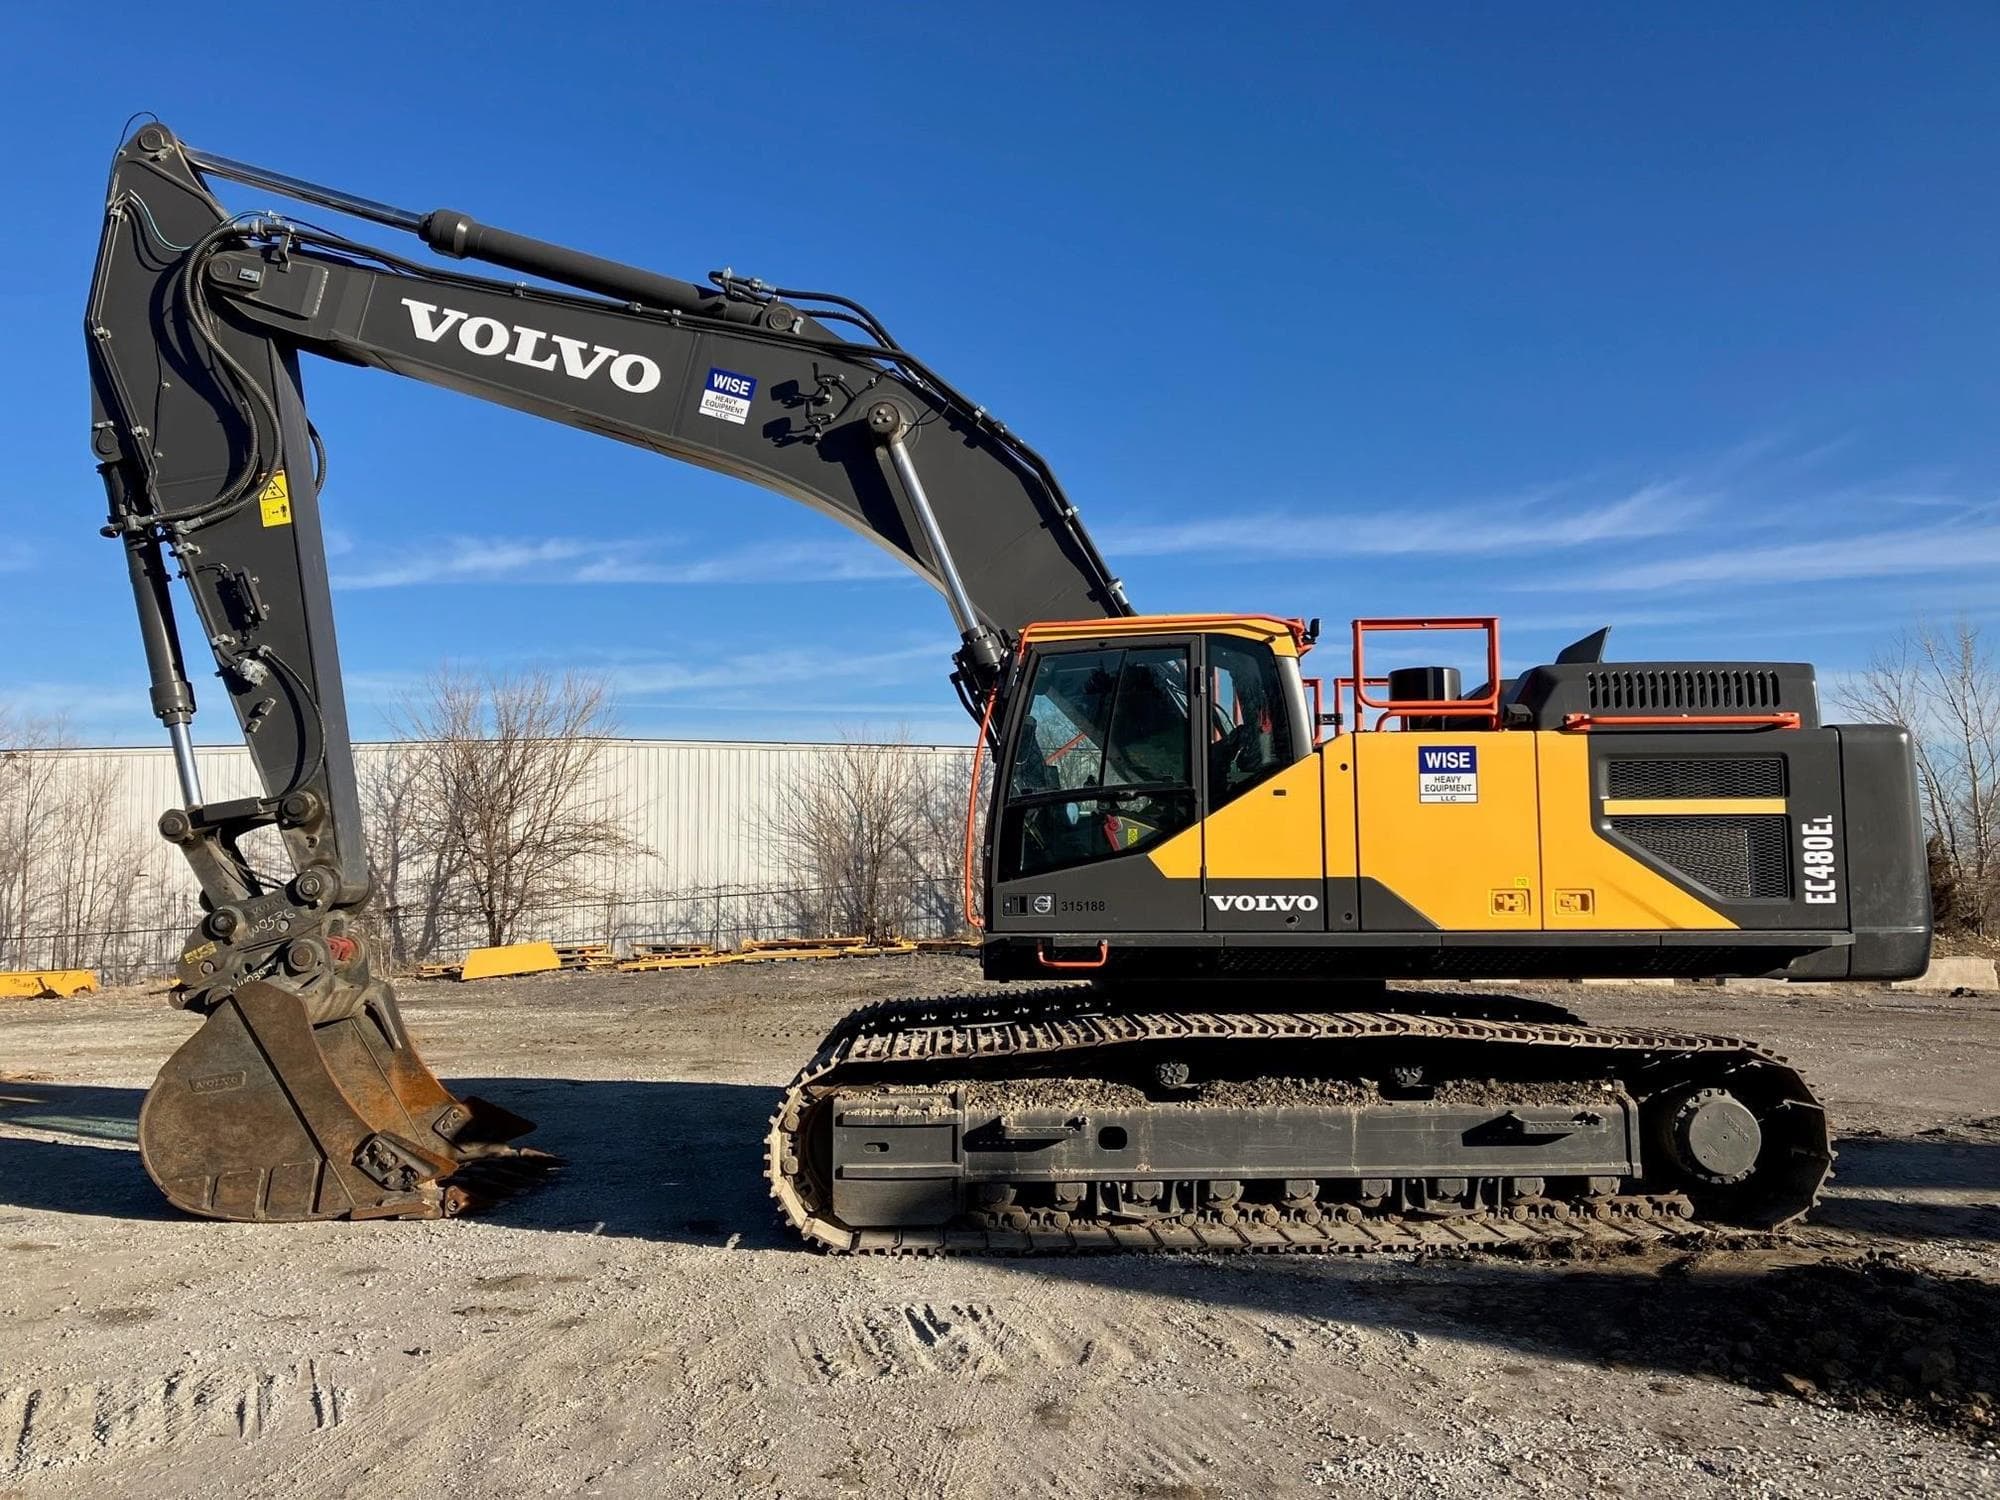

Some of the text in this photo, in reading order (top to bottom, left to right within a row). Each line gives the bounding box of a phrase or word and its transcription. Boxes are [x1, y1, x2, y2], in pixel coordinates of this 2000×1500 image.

[401, 298, 661, 393] VOLVO
[713, 373, 751, 396] WISE
[705, 399, 744, 414] EQUIPMENT
[715, 394, 737, 405] HEAVY
[1424, 751, 1471, 769] WISE
[1434, 775, 1462, 784] HEAVY
[1424, 784, 1472, 792] EQUIPMENT
[1060, 900, 1106, 912] 315188
[1209, 895, 1319, 912] VOLVO
